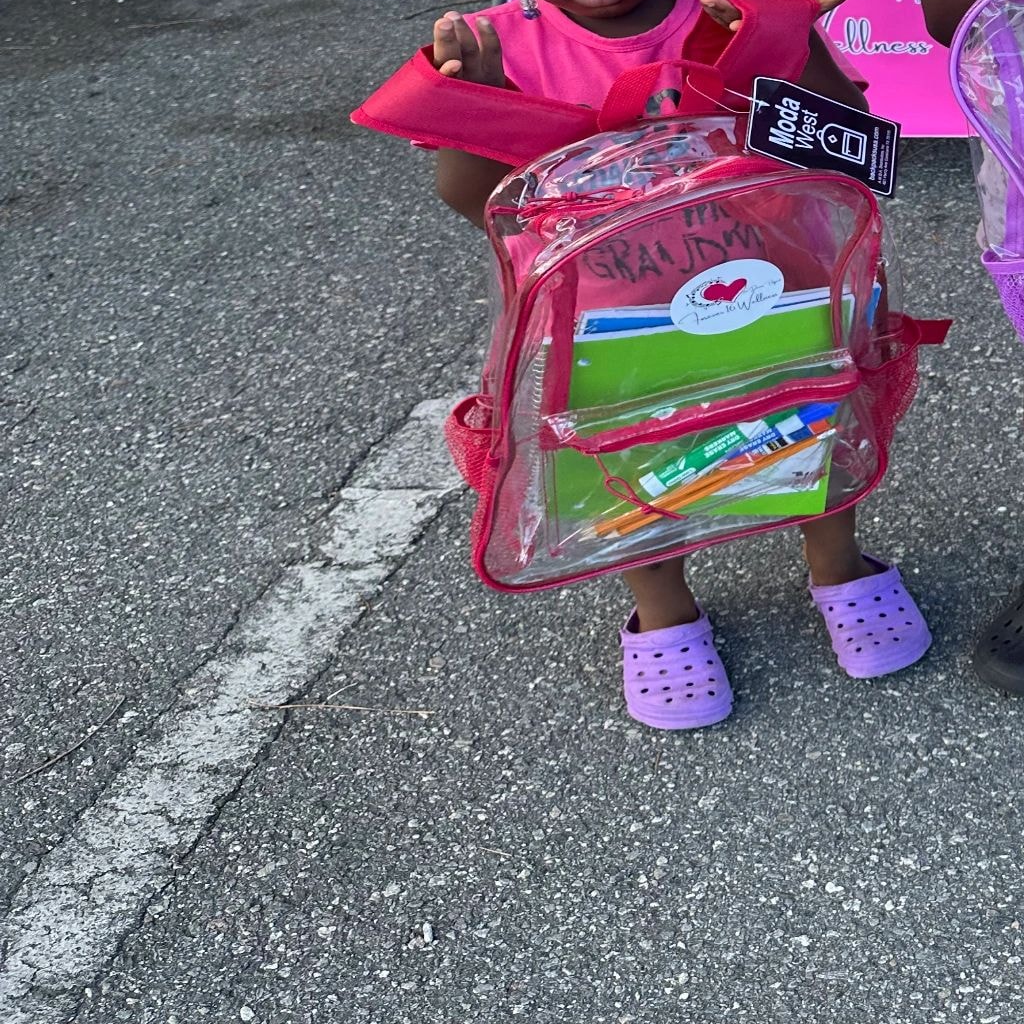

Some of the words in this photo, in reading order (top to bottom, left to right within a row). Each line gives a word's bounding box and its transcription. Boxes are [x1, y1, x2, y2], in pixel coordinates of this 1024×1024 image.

[823, 10, 931, 55] ellness
[769, 97, 800, 149] Moda
[795, 109, 819, 150] West
[704, 430, 736, 452] MARKERS
[704, 442, 727, 458] ERASE
